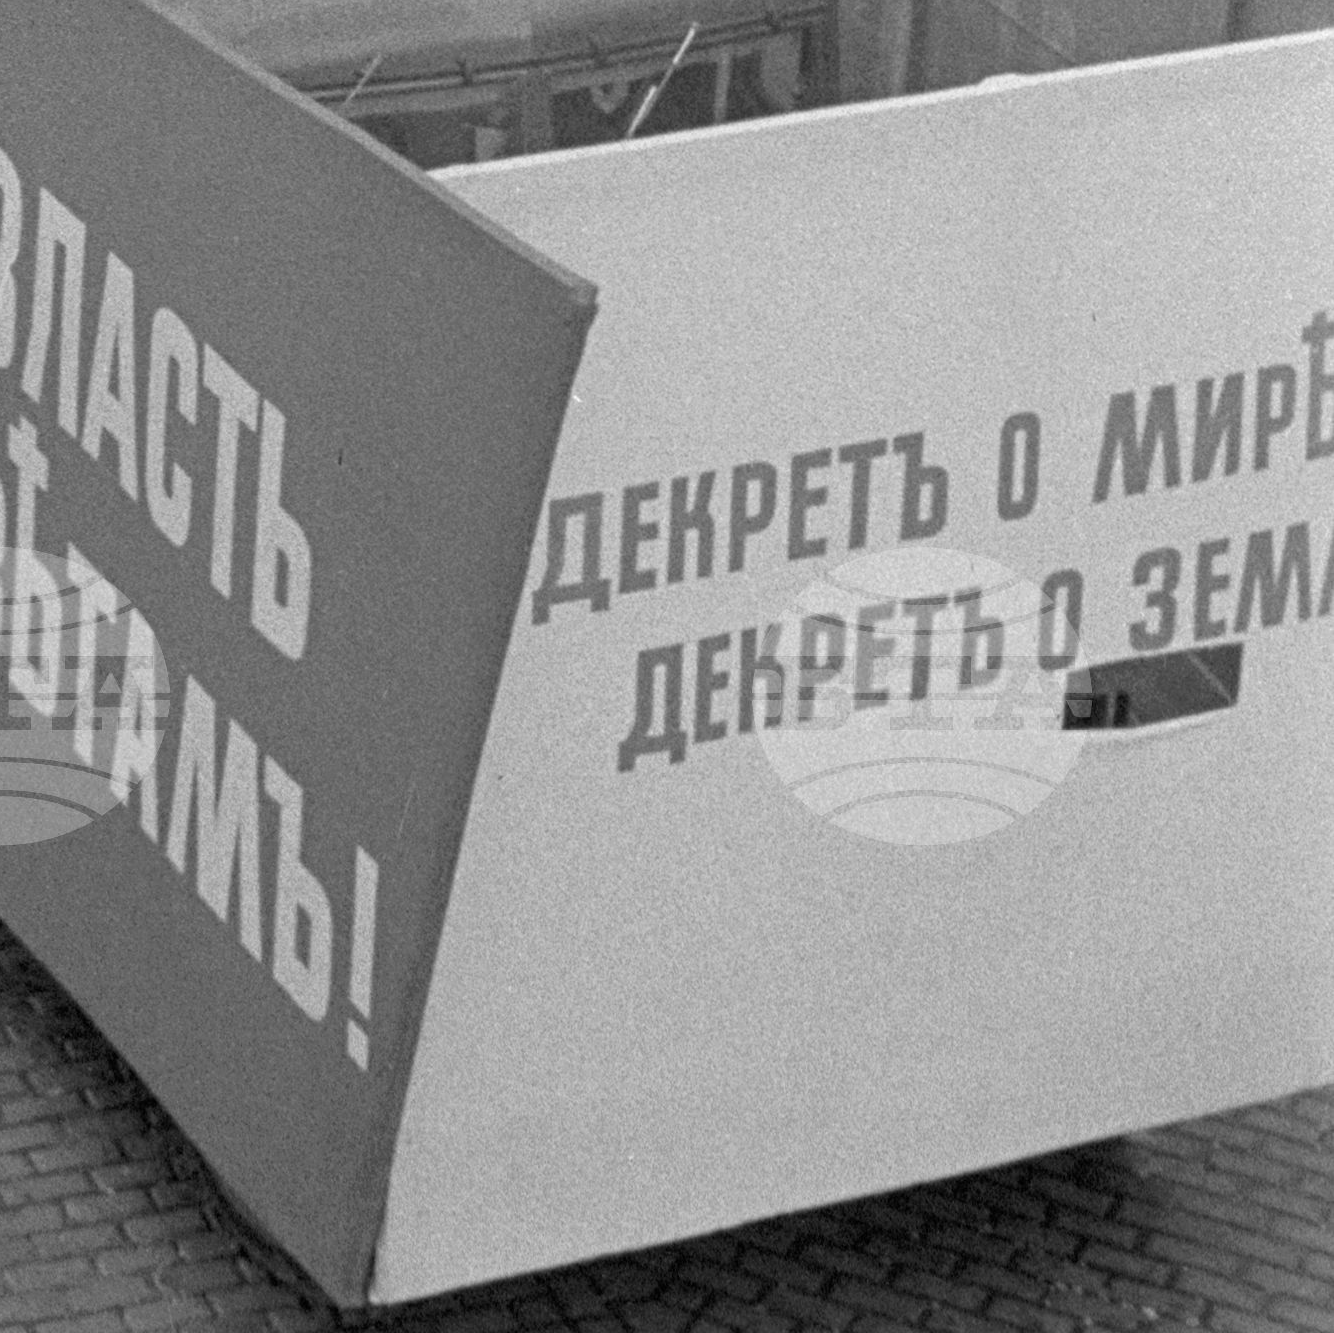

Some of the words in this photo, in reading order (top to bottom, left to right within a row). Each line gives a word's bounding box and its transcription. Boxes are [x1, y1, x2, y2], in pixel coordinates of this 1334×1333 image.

[531, 432, 949, 626] ДЕКРЕТЪ
[997, 411, 1042, 523] О
[617, 588, 1005, 774] ДЕКРЕТЪ
[1036, 569, 1084, 673] О
